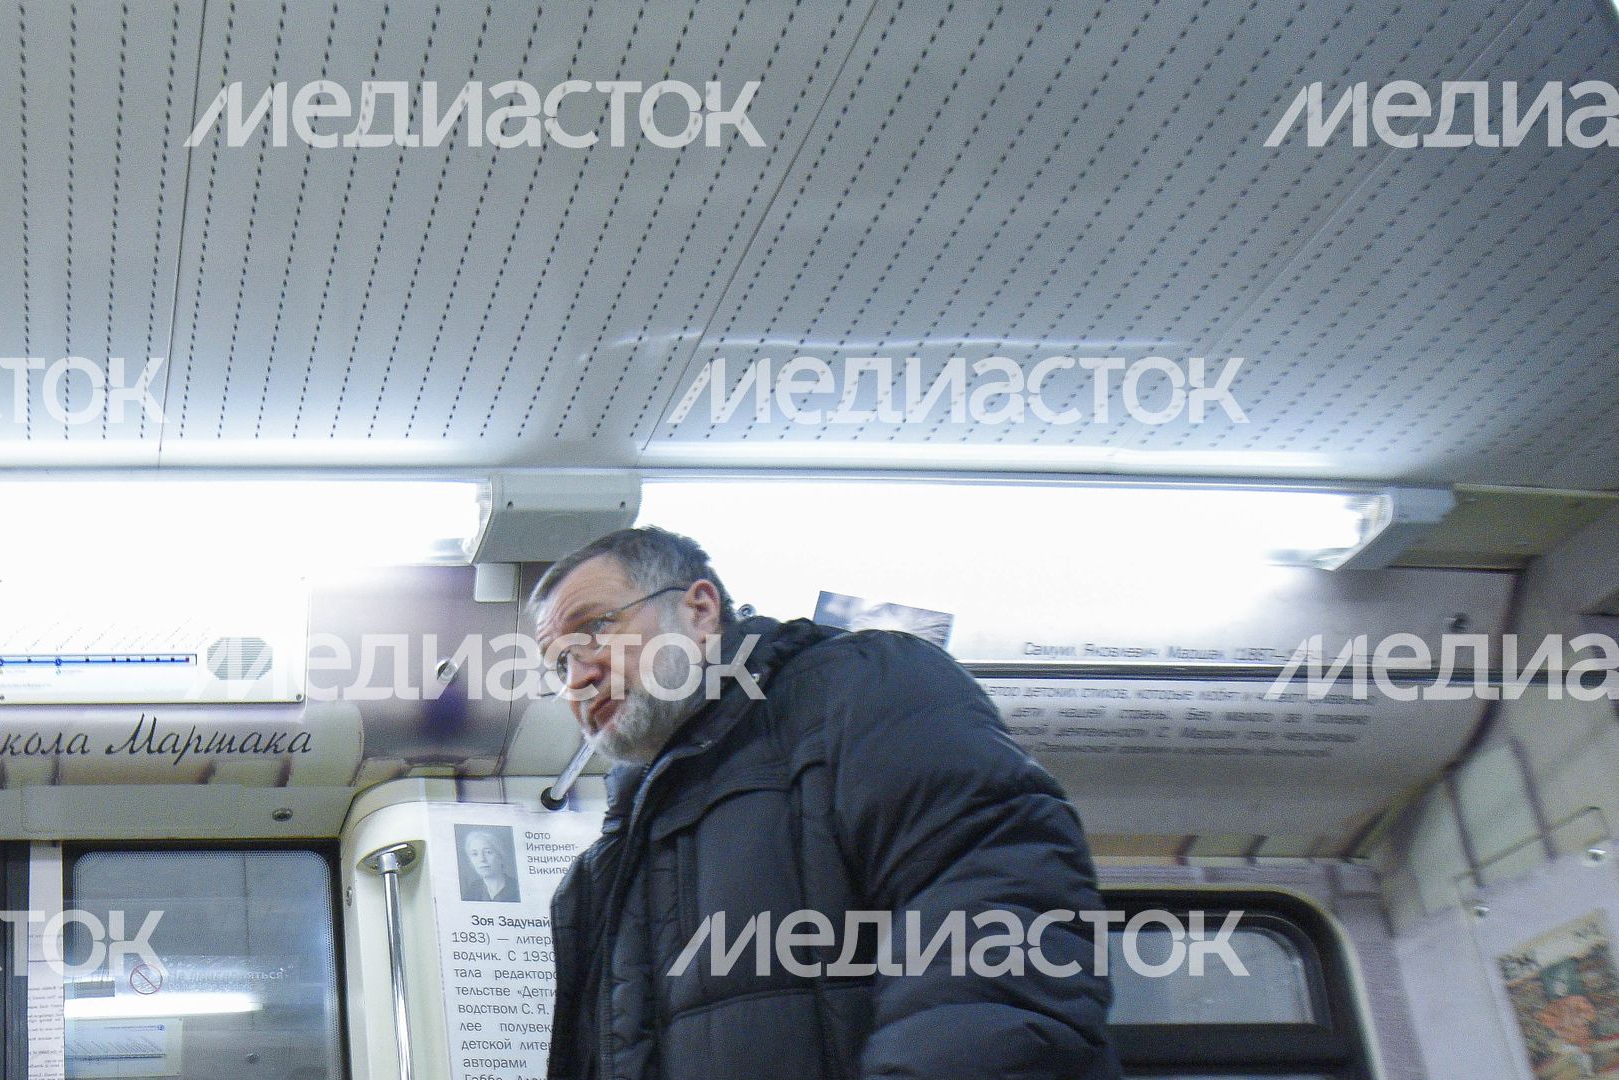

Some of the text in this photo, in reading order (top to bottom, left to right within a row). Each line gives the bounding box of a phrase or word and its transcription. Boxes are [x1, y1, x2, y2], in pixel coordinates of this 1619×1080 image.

[1083, 642, 1159, 658] Яковлевич
[1166, 645, 1223, 660] Маршак
[104, 713, 312, 766] Маршака
[525, 831, 551, 840] Фото
[526, 842, 579, 853] Интернет-
[529, 865, 569, 875] Википе
[471, 914, 495, 927] Зоя
[451, 931, 491, 945] 1983)
[453, 950, 502, 963] водчик.
[507, 950, 517, 962] С
[453, 968, 482, 979] тала
[455, 985, 511, 997] тельстве
[458, 1003, 550, 1015] водством С. Я.
[460, 1022, 482, 1032] лее
[462, 1038, 512, 1051] детской
[463, 1058, 527, 1070] авторами
